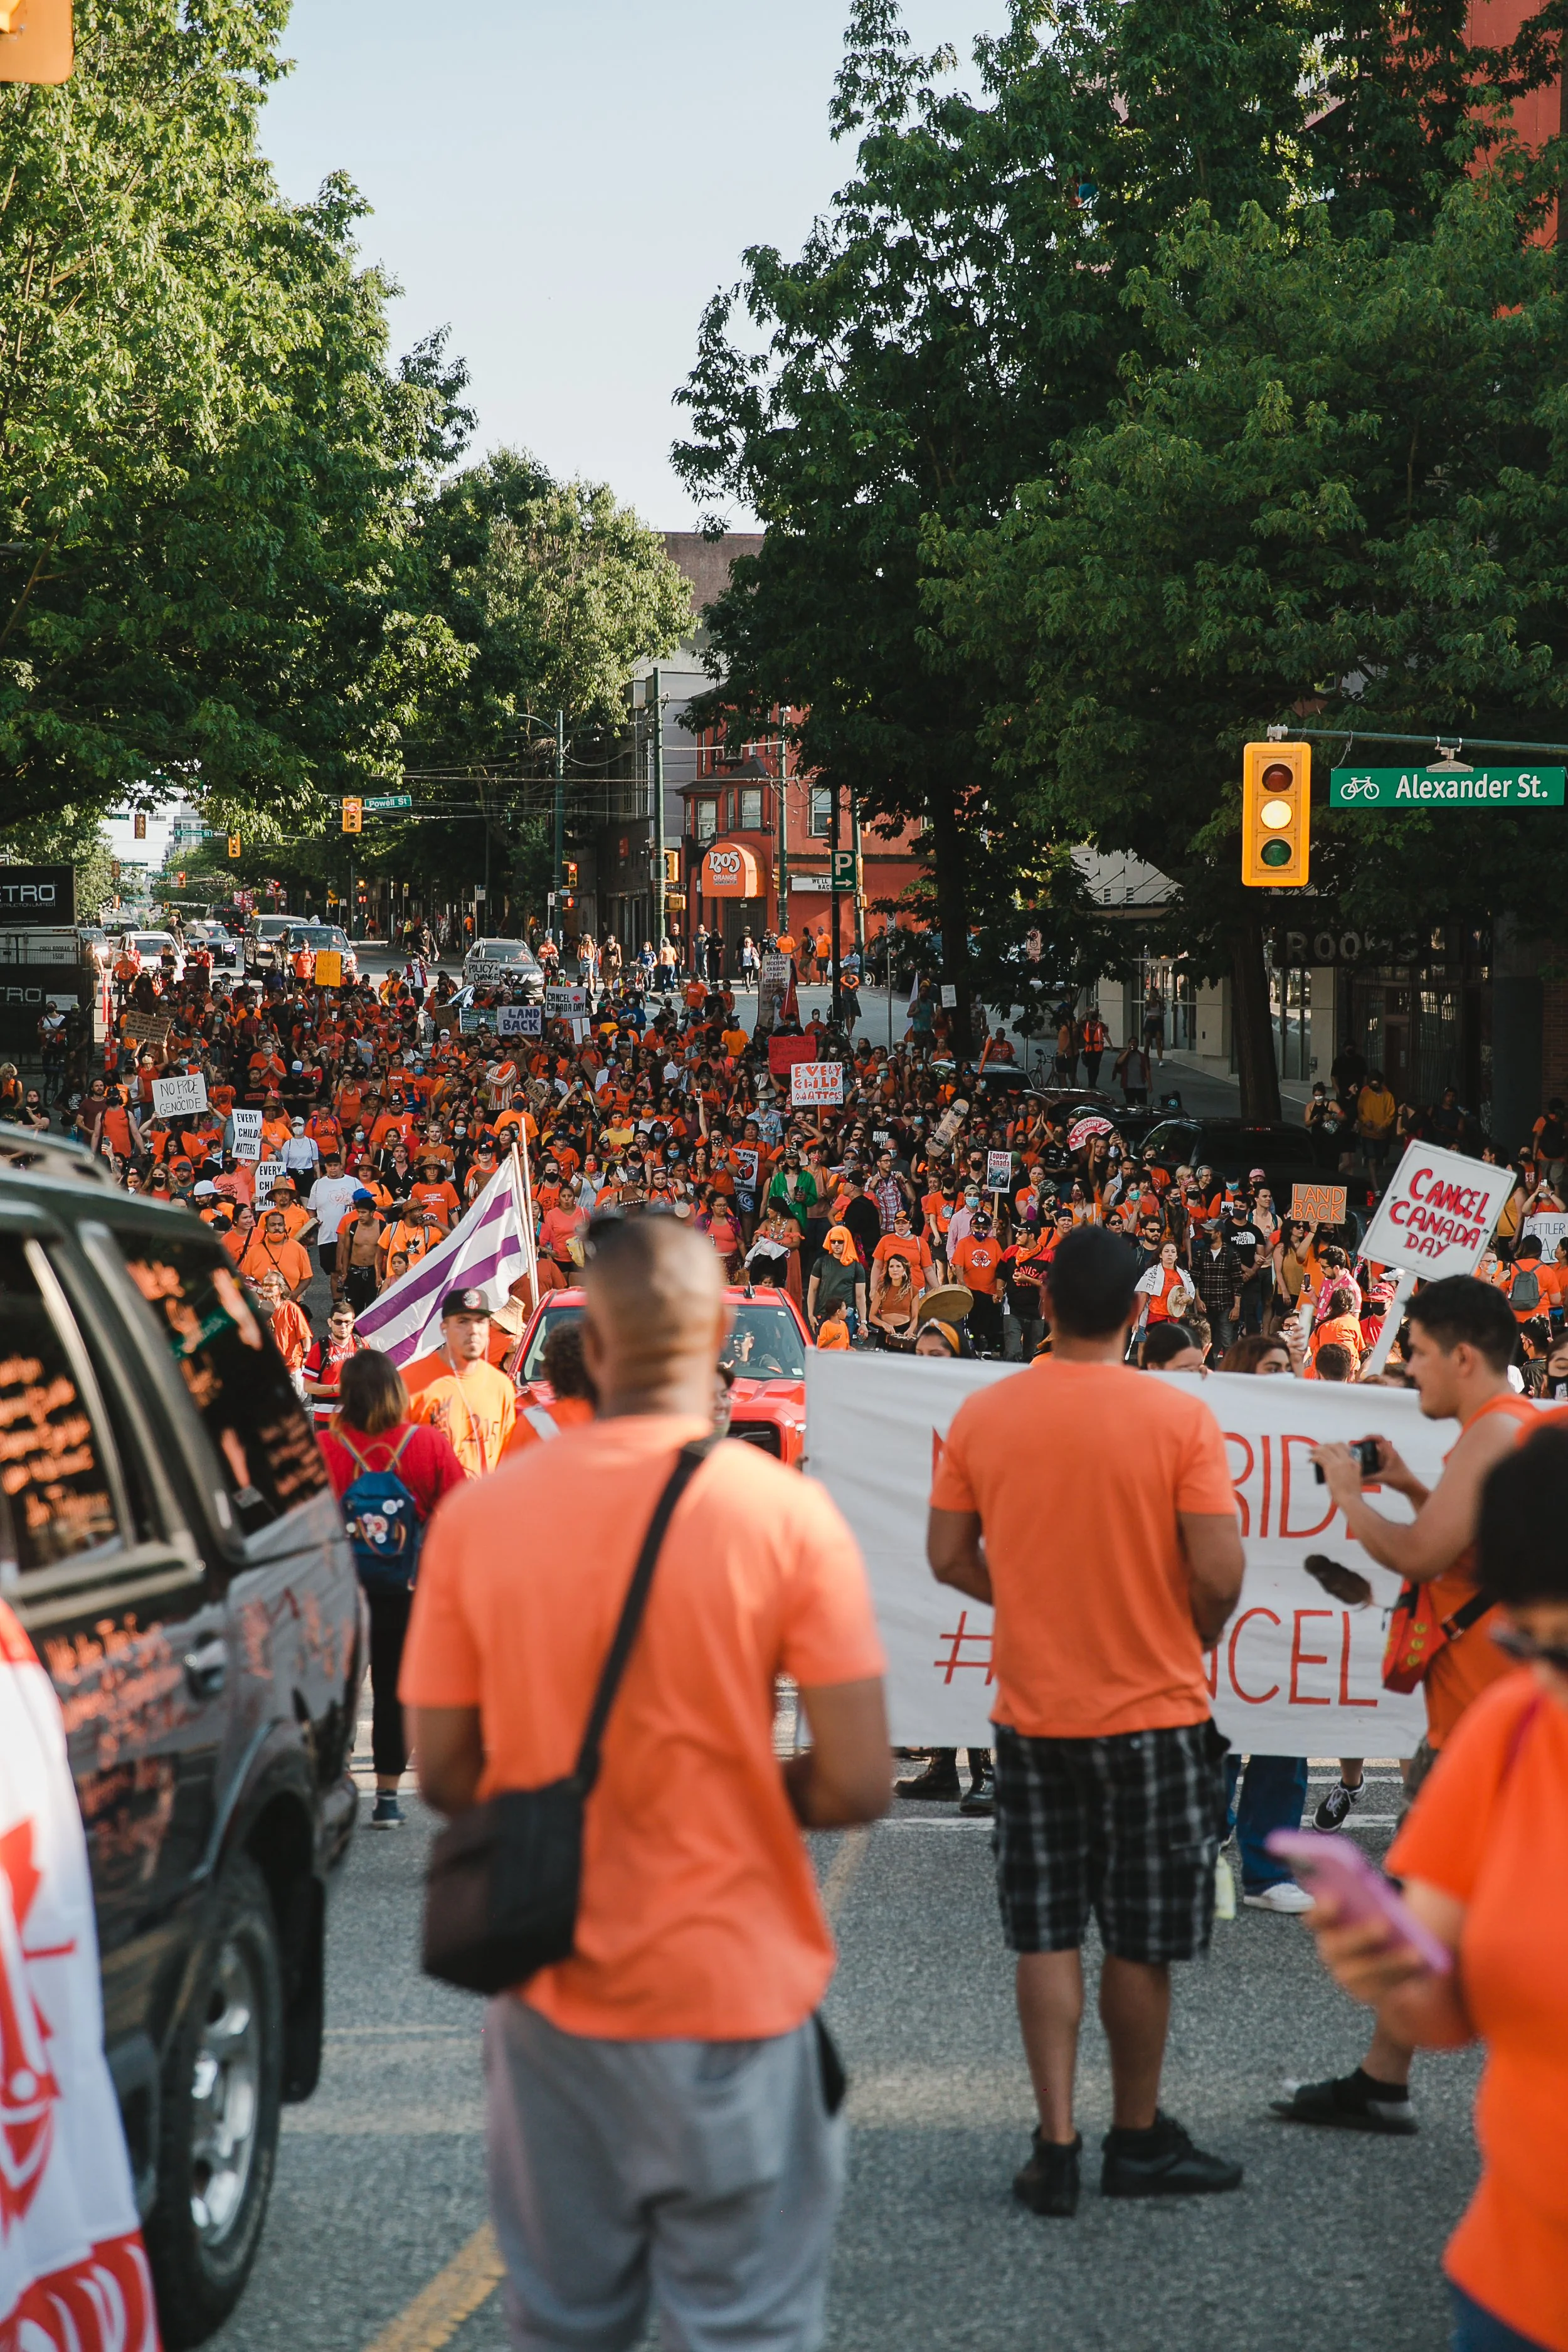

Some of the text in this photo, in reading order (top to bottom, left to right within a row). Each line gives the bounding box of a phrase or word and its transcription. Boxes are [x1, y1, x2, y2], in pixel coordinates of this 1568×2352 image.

[1396, 773, 1548, 799] Alexander St.
[369, 799, 395, 807] Powell
[835, 854, 852, 876] P
[0, 885, 55, 902] TRO
[469, 964, 494, 973] POLICY
[474, 973, 499, 982] CHANGE
[547, 993, 570, 1002] CANCEL
[546, 1003, 585, 1012] CANADA DAY
[508, 1009, 540, 1019] LAND
[502, 1019, 539, 1031] BACK
[795, 1065, 842, 1078] EVERY
[161, 1083, 175, 1097] NO
[160, 1098, 201, 1115] GENOCIDE
[236, 1113, 257, 1123] EVERY
[238, 1128, 258, 1138] CHILD
[235, 1143, 255, 1155] MATTERS
[990, 1152, 1008, 1160] Topple
[260, 1165, 282, 1175] EVERY
[1294, 1185, 1345, 1204] LAND
[1409, 1168, 1490, 1225] CANCEL
[1293, 1202, 1342, 1221] BACK
[1402, 1232, 1451, 1259] DAY
